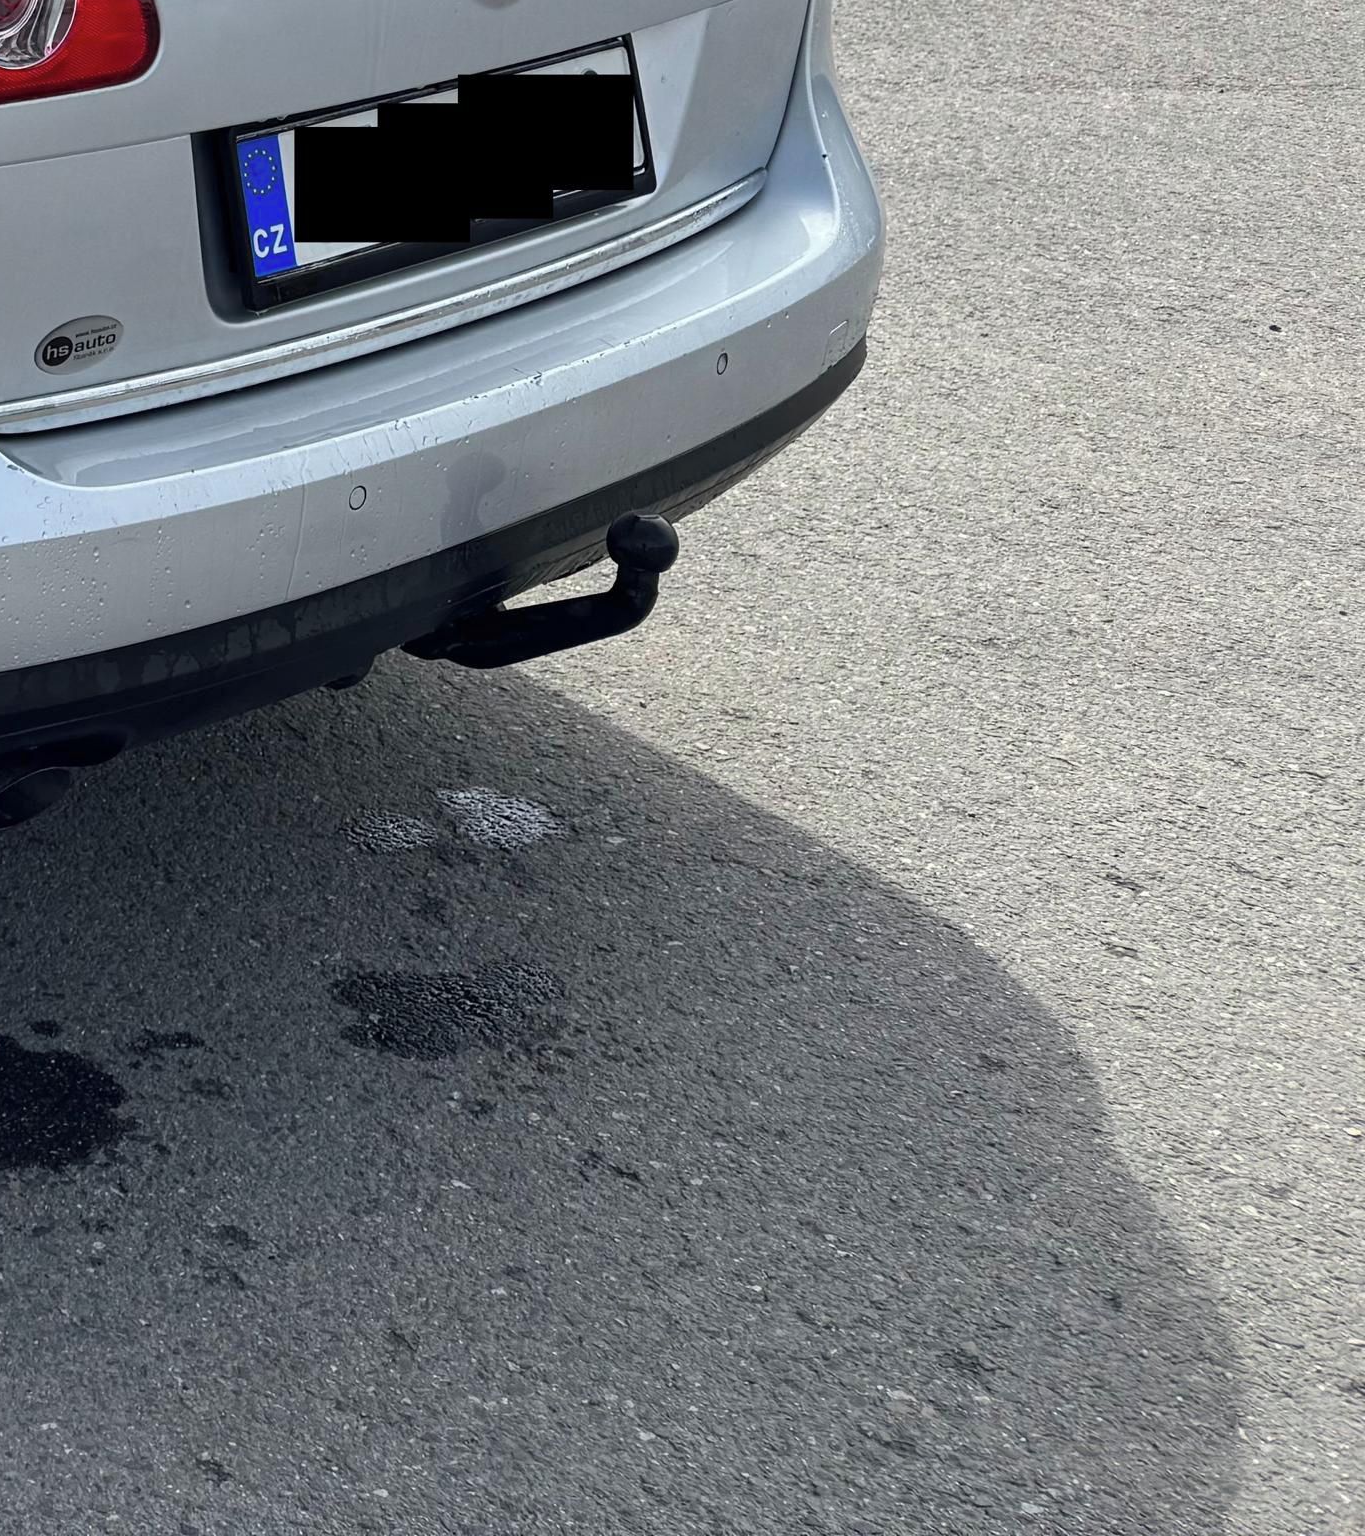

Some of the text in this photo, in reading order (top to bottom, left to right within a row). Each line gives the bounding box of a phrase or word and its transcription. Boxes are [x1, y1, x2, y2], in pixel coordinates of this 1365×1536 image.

[253, 223, 288, 258] CZ
[46, 344, 70, 361] hs
[74, 333, 116, 353] auto
